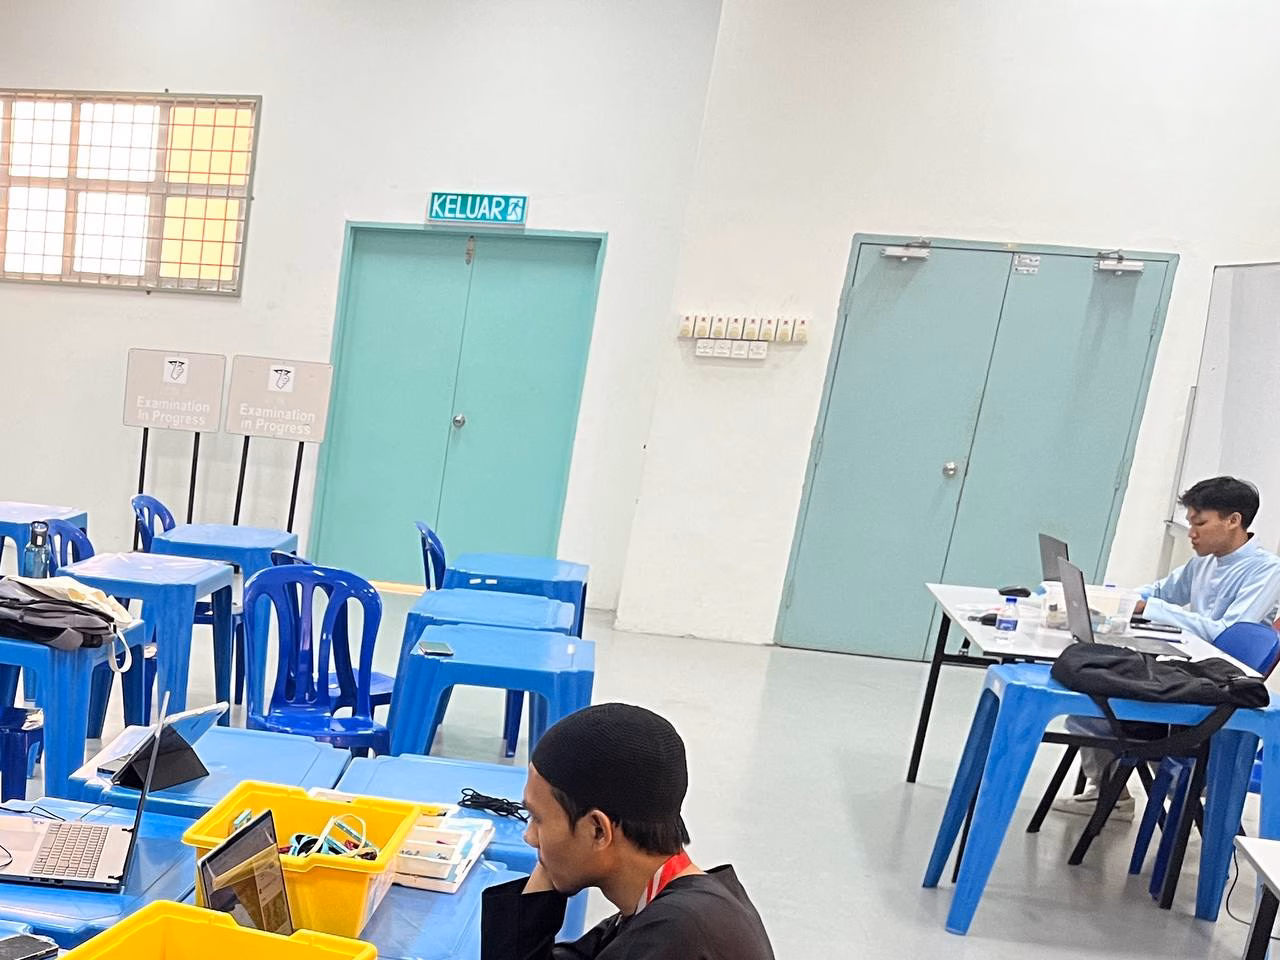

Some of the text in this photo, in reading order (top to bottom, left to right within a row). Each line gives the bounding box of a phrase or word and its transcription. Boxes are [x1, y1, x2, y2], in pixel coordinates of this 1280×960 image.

[431, 194, 506, 220] KELUAR
[136, 395, 210, 414] Examination
[239, 403, 316, 422] Examination
[152, 409, 207, 426] Progress
[240, 417, 312, 435] in Progress
